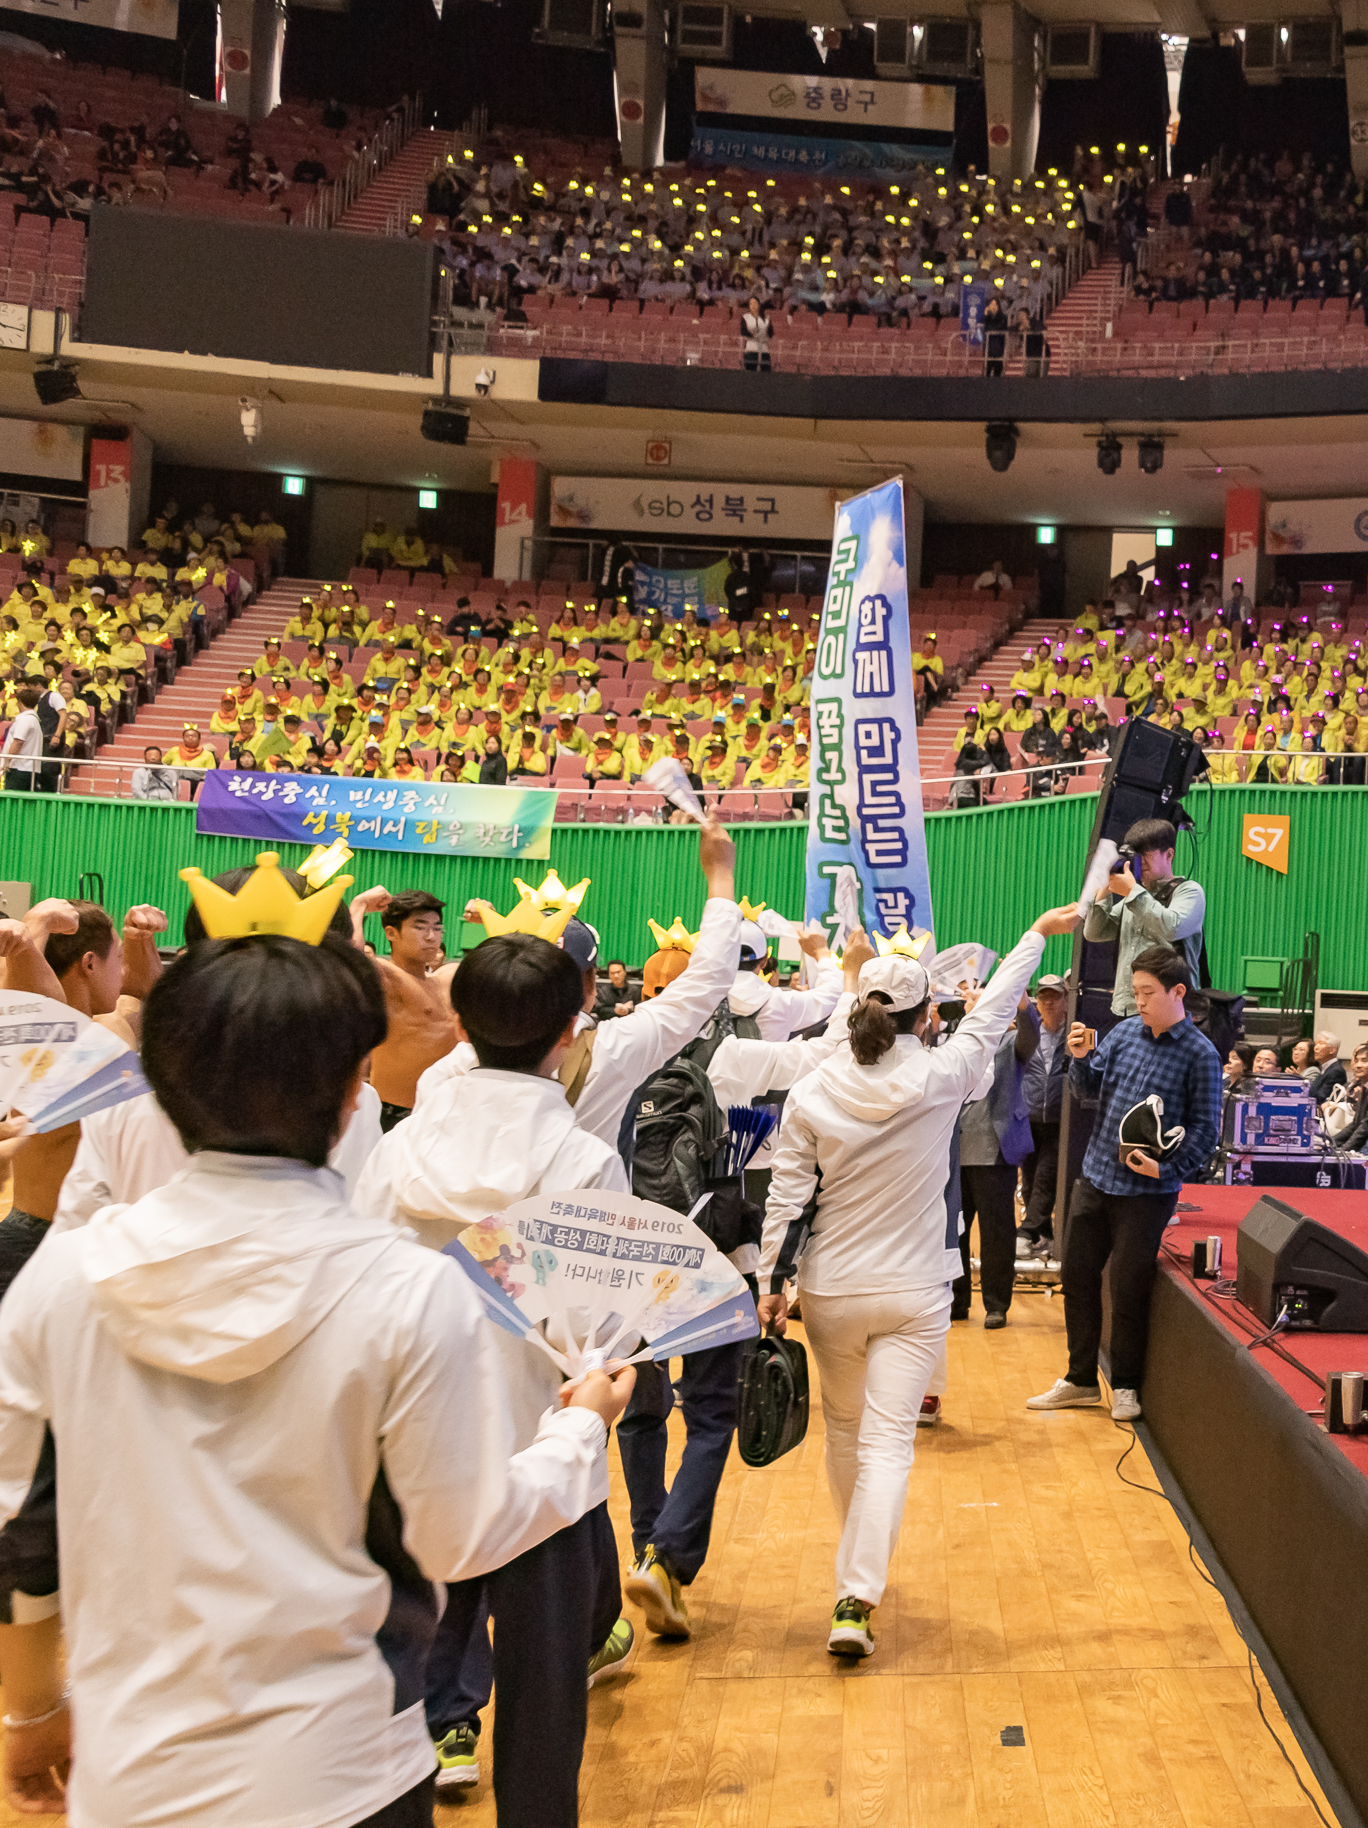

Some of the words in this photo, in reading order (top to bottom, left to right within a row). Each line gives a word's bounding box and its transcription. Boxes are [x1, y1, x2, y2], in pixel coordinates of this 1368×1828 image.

[804, 86, 877, 113] 중랑구
[95, 464, 126, 488] 13
[501, 501, 528, 525] 14
[690, 493, 780, 524] 성북구
[1229, 531, 1254, 555] 15
[819, 535, 860, 680] 구민이
[853, 593, 896, 698] 함께
[816, 697, 850, 845] 꿈꾸는
[854, 717, 908, 869] 만드는
[302, 810, 406, 840] 성북에서
[415, 820, 466, 846] 답을
[1247, 826, 1284, 853] S7
